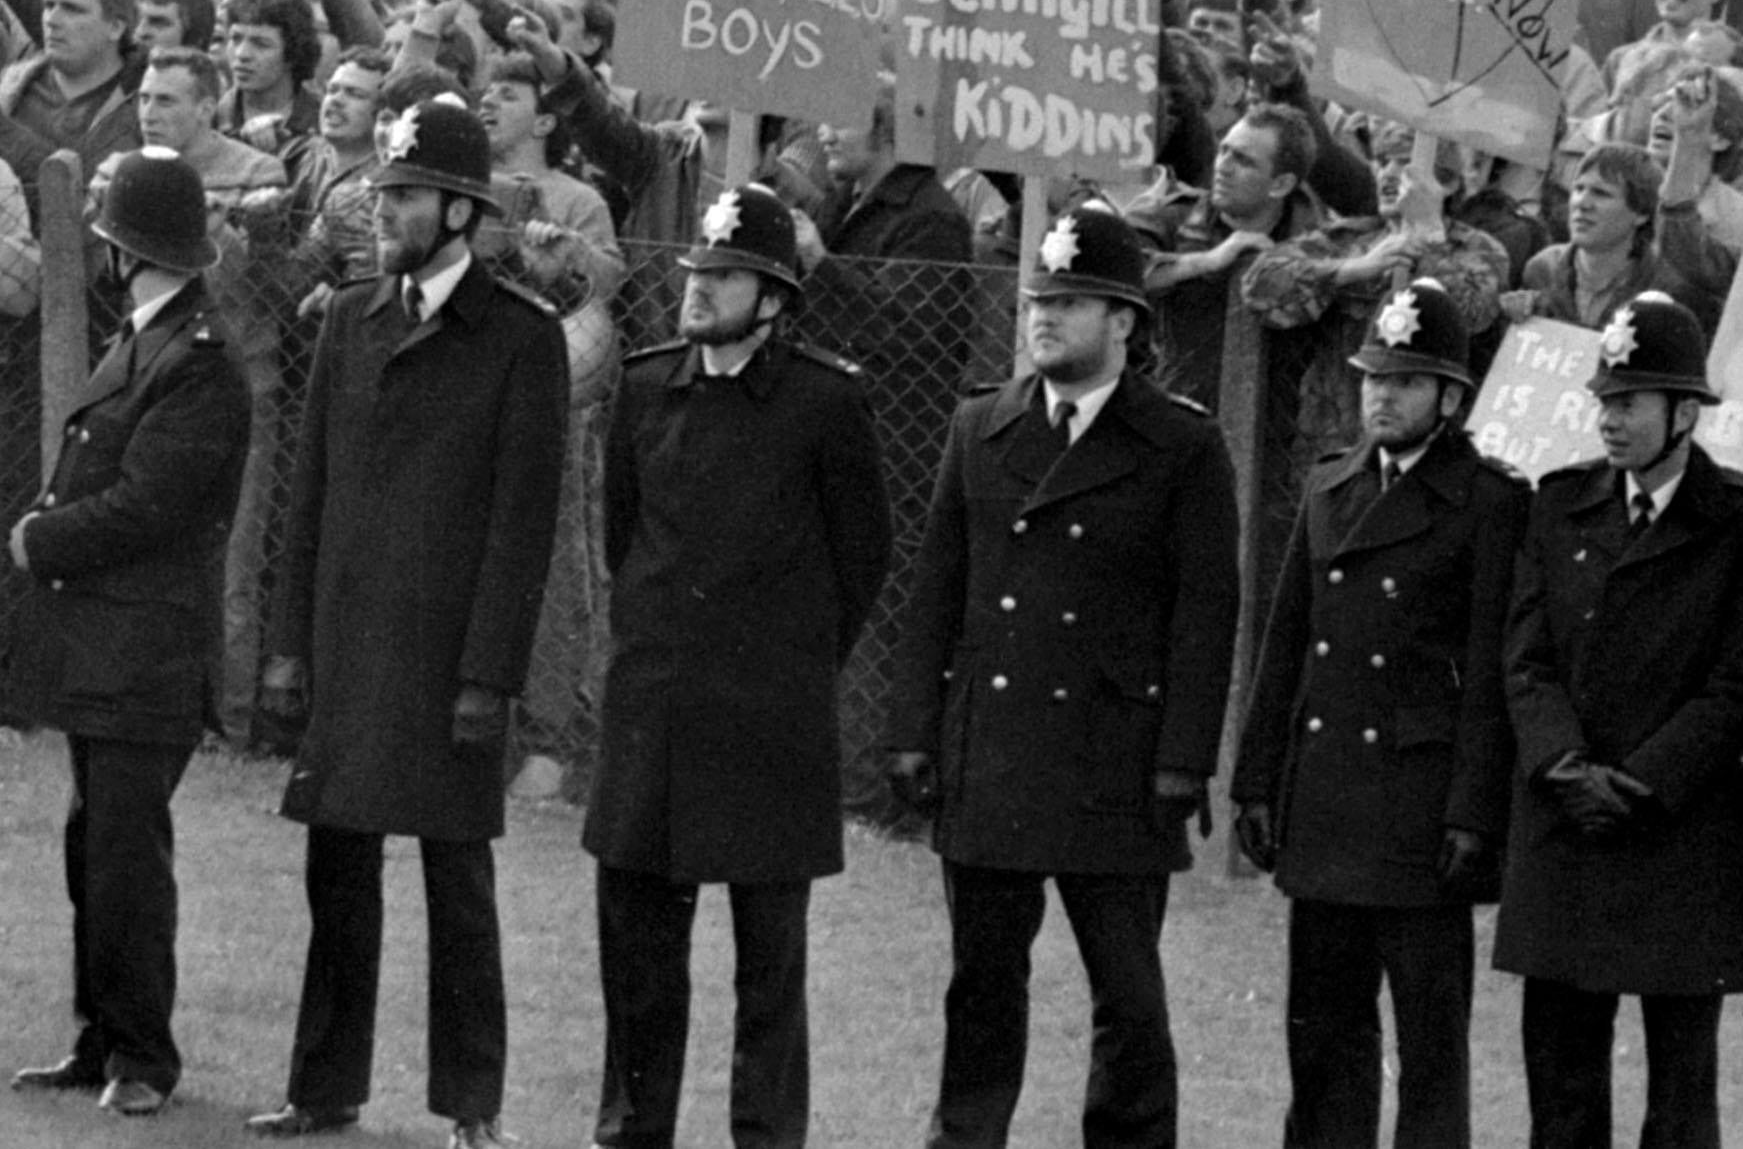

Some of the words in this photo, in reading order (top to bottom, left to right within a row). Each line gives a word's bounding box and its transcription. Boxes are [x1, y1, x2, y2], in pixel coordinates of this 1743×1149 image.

[903, 15, 1035, 70] THINK
[1070, 40, 1158, 93] HE'S
[1516, 330, 1584, 377] THE
[1493, 385, 1535, 417] IS
